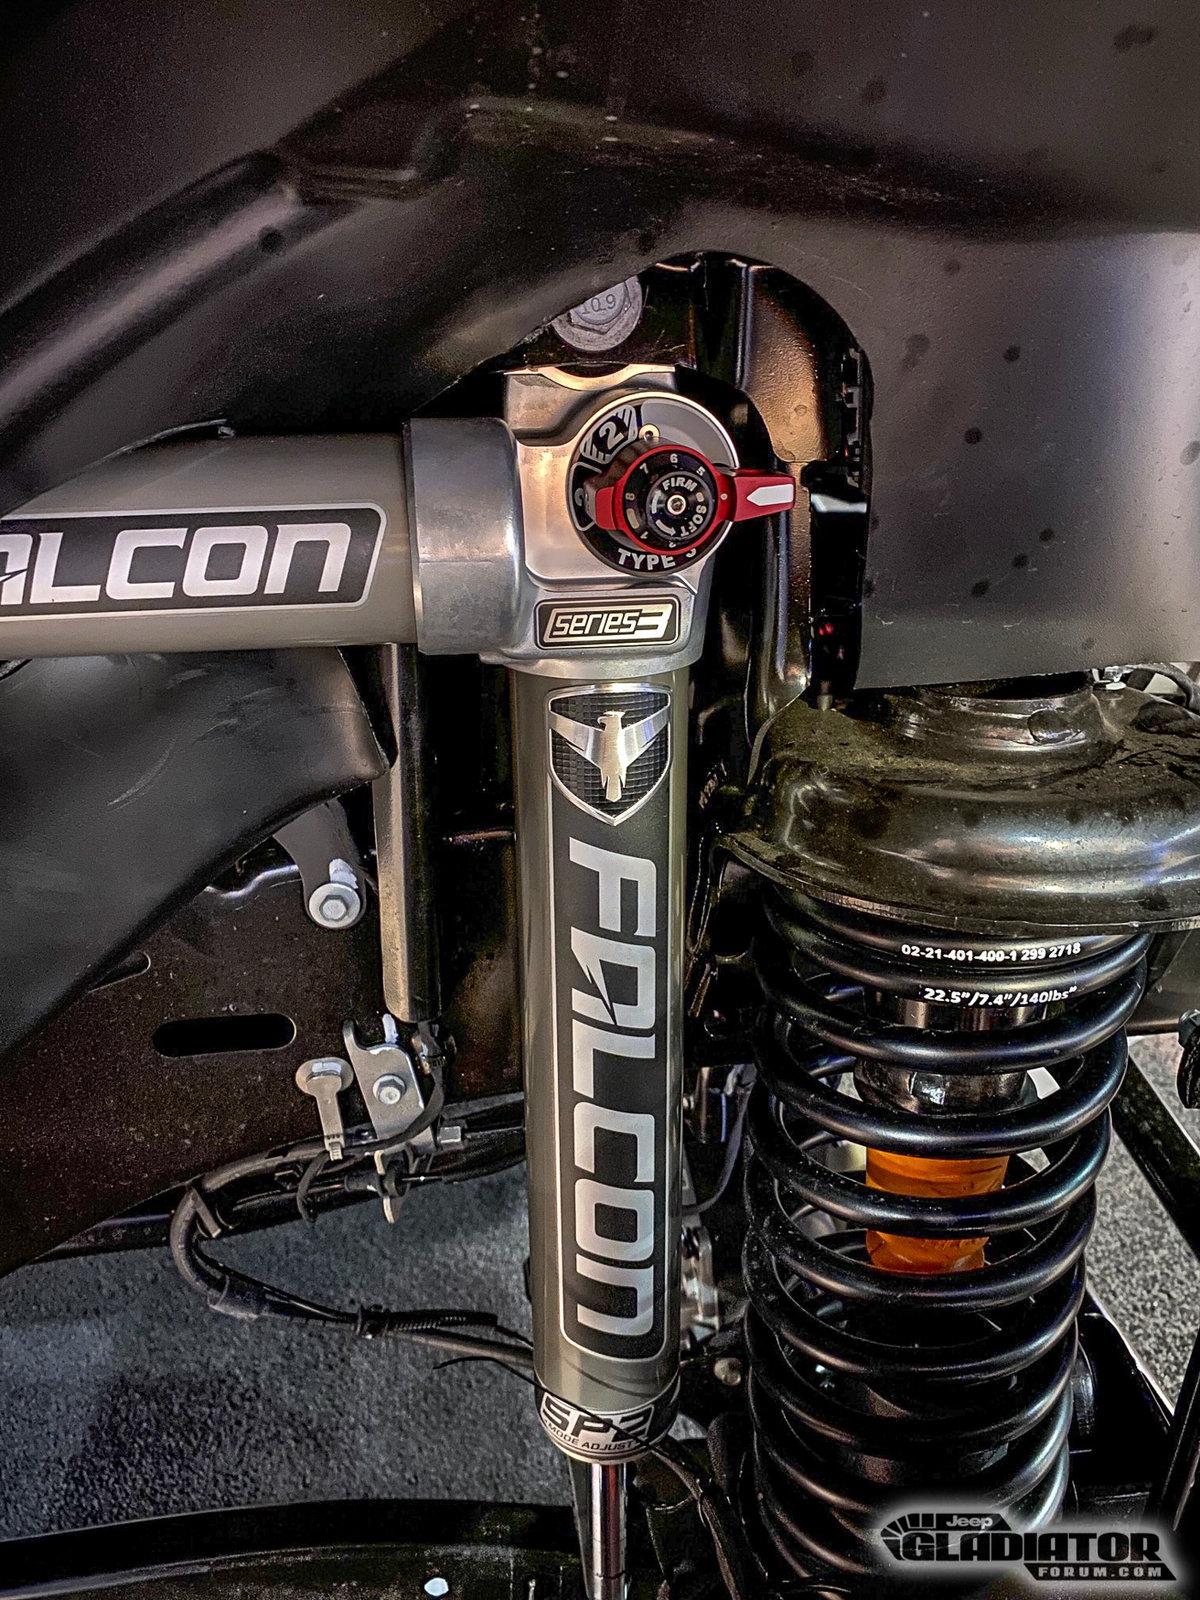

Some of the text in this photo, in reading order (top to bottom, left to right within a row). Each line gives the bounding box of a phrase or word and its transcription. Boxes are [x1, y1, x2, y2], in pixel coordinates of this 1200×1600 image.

[599, 421, 625, 450] 2
[669, 453, 679, 464] 6
[639, 463, 649, 474] 7
[696, 466, 706, 476] 5
[662, 477, 697, 492] FIRM
[625, 492, 635, 502] 8
[681, 505, 707, 537] SOFT
[618, 548, 676, 570] TYPE
[901, 942, 1081, 962] 02-21-401-400-1 299 2718
[569, 837, 657, 1338] FALCON
[582, 1441, 634, 1451] ADJUST
